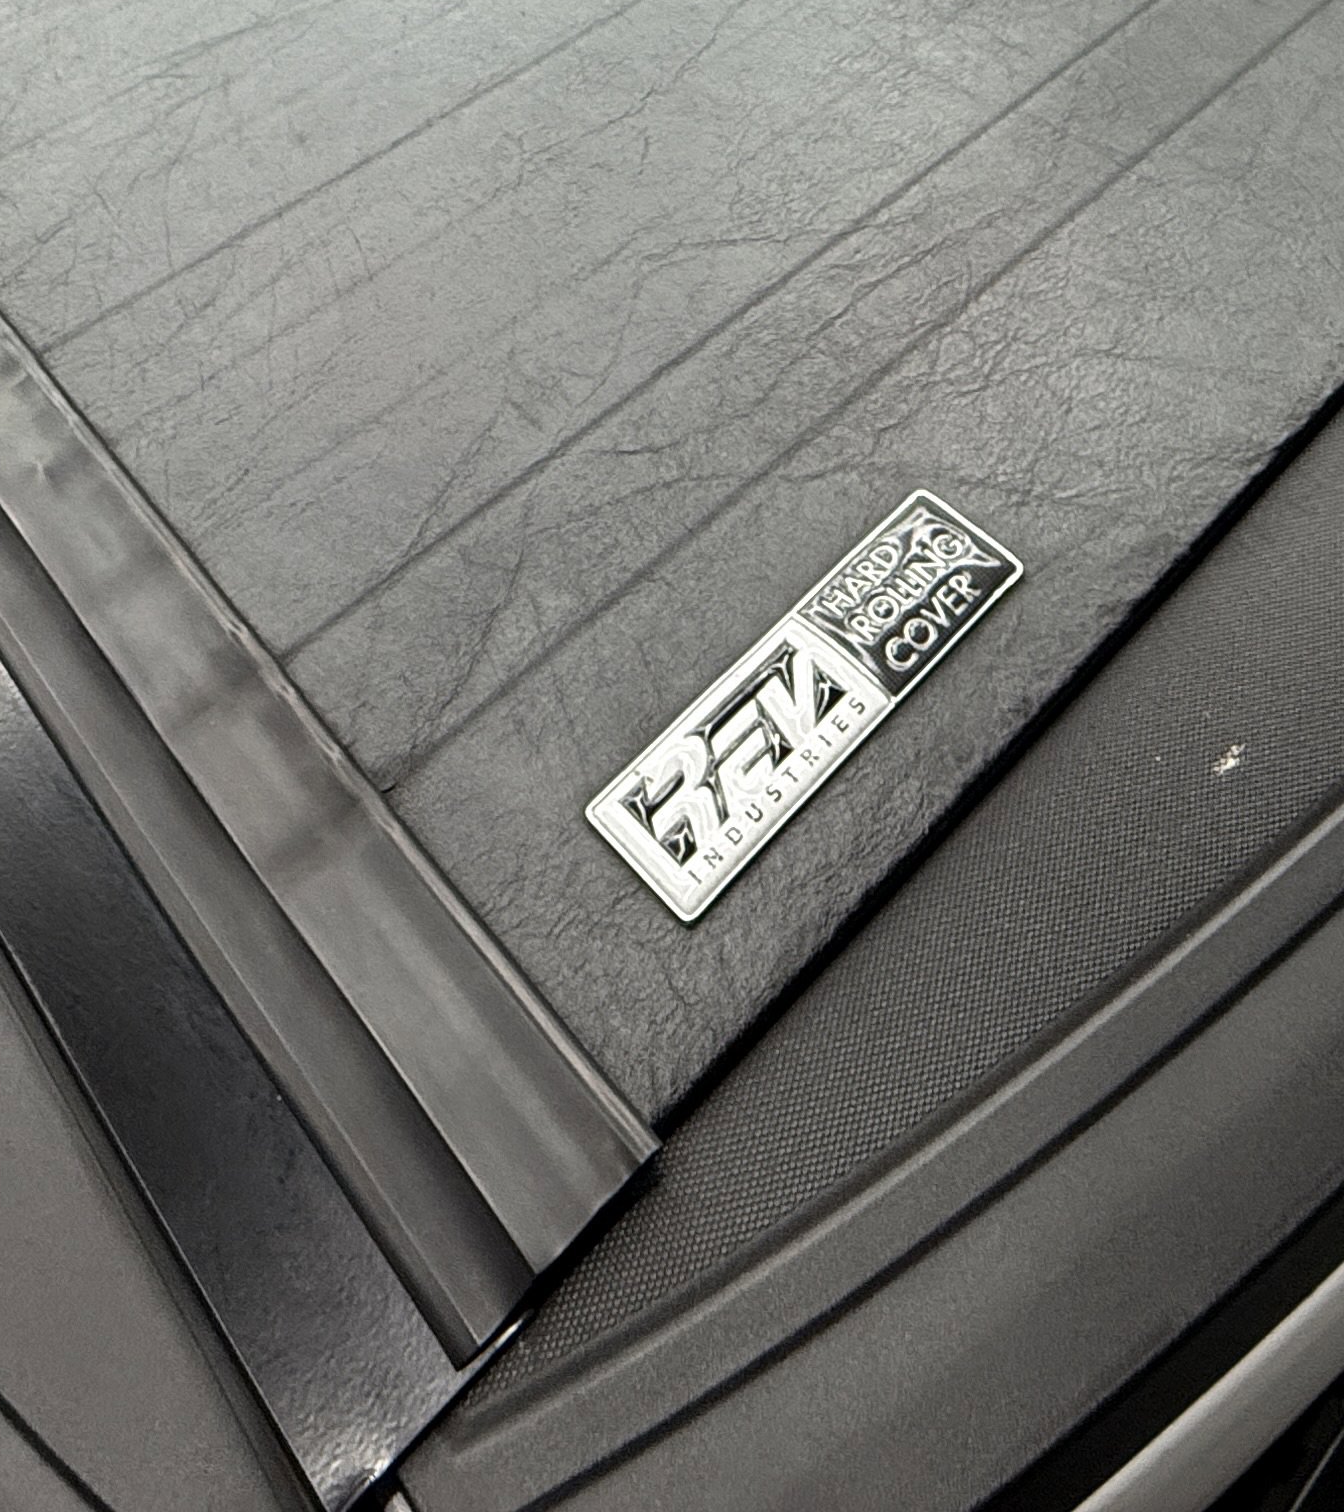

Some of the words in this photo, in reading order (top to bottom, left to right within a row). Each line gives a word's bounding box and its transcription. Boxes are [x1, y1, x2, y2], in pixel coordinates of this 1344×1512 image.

[820, 544, 900, 619] HARD
[849, 533, 964, 642] ROLLING
[885, 572, 982, 672] COVER
[687, 697, 867, 885] INDUSTRIES
